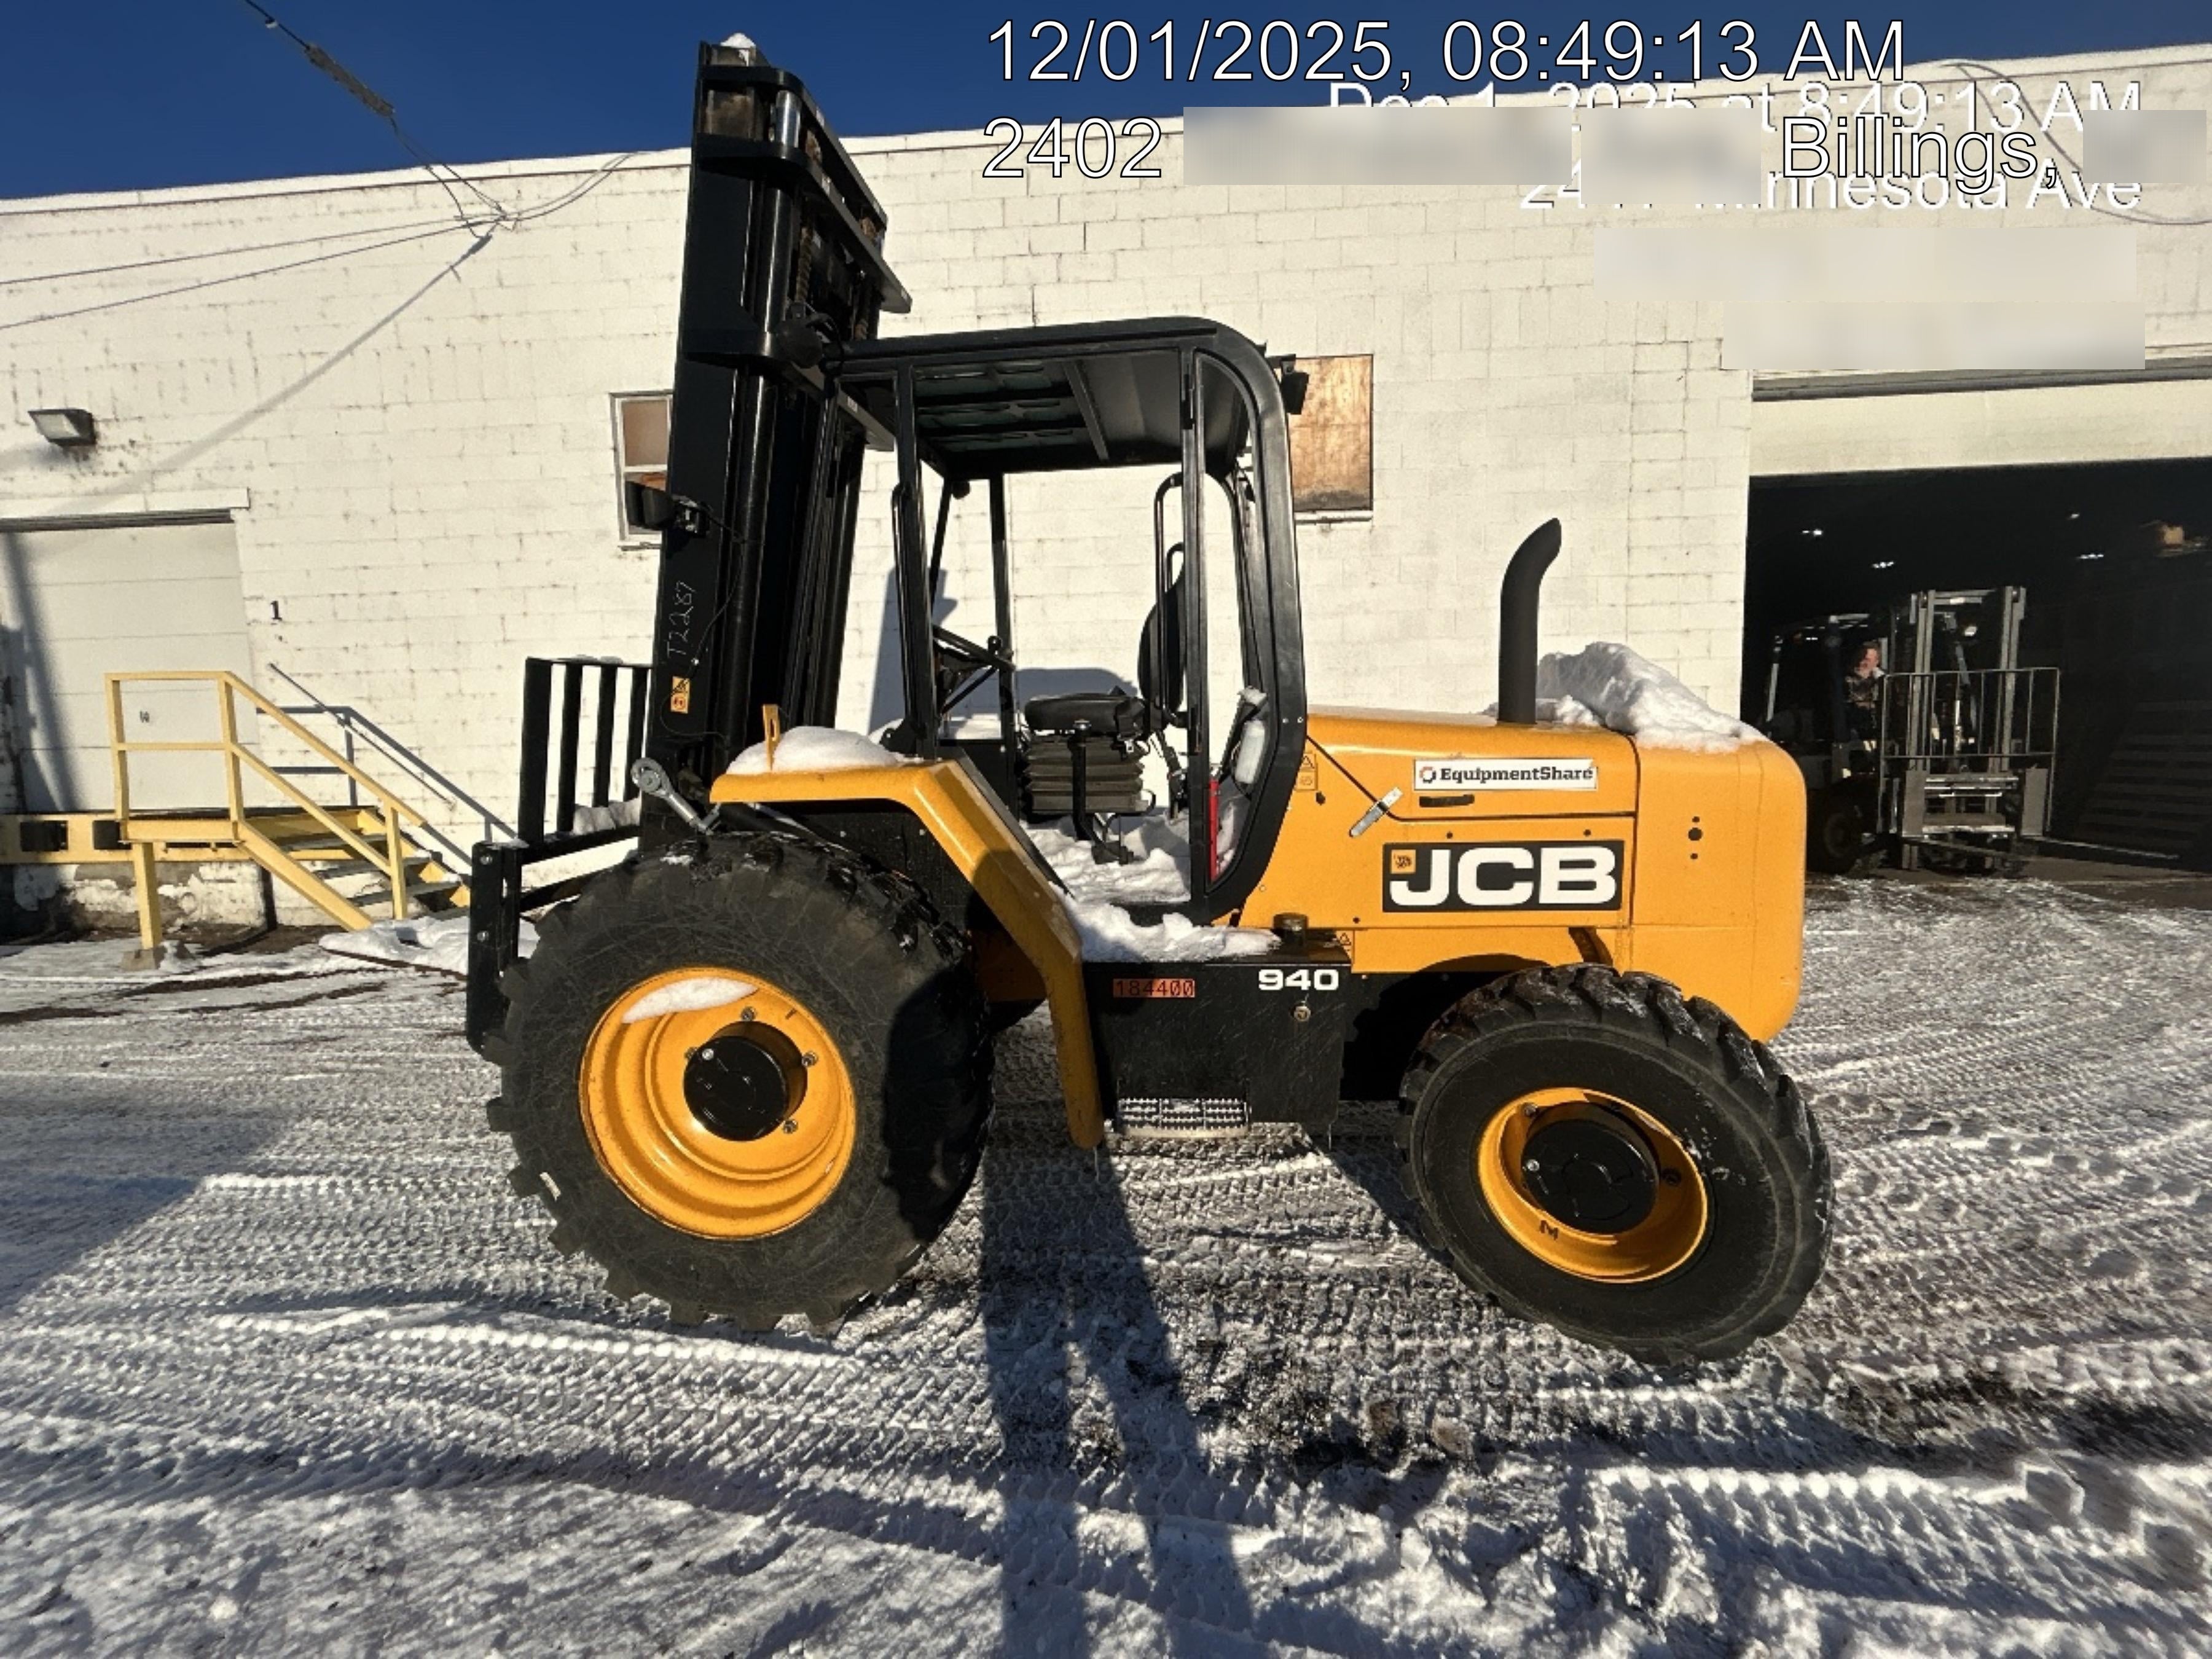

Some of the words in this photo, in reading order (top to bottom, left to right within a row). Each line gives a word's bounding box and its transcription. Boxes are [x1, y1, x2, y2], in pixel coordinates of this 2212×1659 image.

[270, 600, 283, 622] 1
[1440, 766, 1594, 785] EquipmentShare
[1389, 845, 1617, 906] JCB
[1115, 979, 1194, 997] 184400
[1258, 968, 1339, 990] 940
